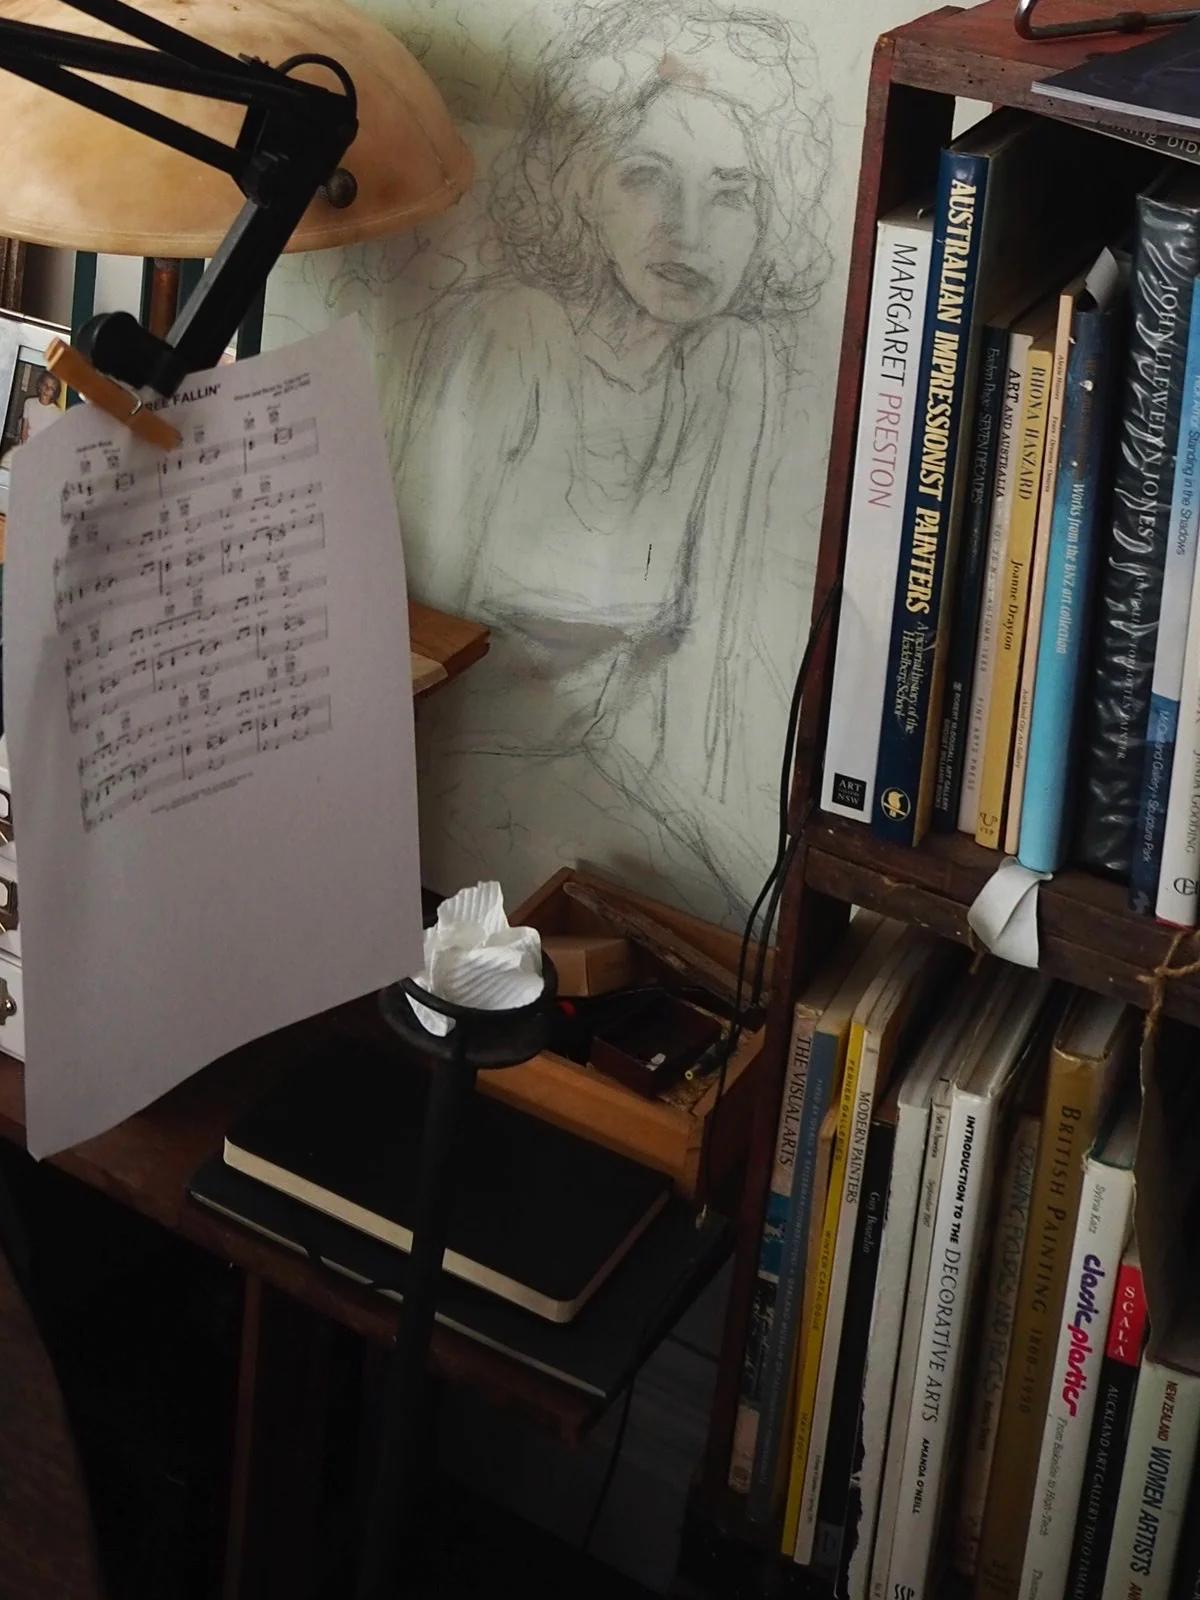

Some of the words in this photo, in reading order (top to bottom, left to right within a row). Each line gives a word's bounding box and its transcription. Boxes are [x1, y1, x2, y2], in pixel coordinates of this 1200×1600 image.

[936, 179, 977, 324] AUSTRALIAN
[881, 242, 918, 386] MARGARET
[1156, 282, 1180, 342] JOHN
[1005, 368, 1022, 403] ART
[1026, 367, 1046, 420] RHONA
[918, 330, 962, 500] IMPRESSIONIST
[1002, 405, 1014, 429] AND
[868, 392, 903, 508] PRESTON
[995, 432, 1010, 499] AUSTRALIA
[1018, 428, 1041, 500] HASZARD
[1182, 430, 1199, 475] Standing
[1069, 483, 1085, 516] Works
[1138, 468, 1161, 539] JONES
[1181, 489, 1194, 506] the
[1184, 477, 1195, 487] in
[1064, 545, 1080, 561] the
[1067, 517, 1082, 543] from
[1175, 508, 1193, 555] Shadows
[905, 507, 941, 614] PAINTERS
[1011, 560, 1024, 600] Joanne
[1063, 563, 1077, 586] BNZ
[1061, 588, 1075, 603] art
[1003, 604, 1020, 650] Drayton
[1055, 605, 1074, 654] collection
[908, 671, 924, 703] history
[793, 1036, 813, 1068] THE
[783, 1072, 809, 1122] VISUAL
[854, 1091, 872, 1145] MODERN
[779, 1127, 799, 1166] ARTS
[955, 1115, 976, 1202] INTRODUCTION
[1049, 1105, 1082, 1196] BRITISH
[845, 1147, 864, 1205] PAINTERS
[949, 1222, 961, 1244] THE
[952, 1204, 964, 1219] TO
[1031, 1206, 1067, 1313] PAINTING
[929, 1248, 961, 1373] DECORATIVE
[1113, 1285, 1136, 1357] SCALA
[921, 1376, 942, 1422] ARTS
[1163, 1381, 1178, 1403] NEW
[1099, 1386, 1119, 1447] AUCKLAND
[1156, 1403, 1176, 1442] ZEALAND
[917, 1438, 930, 1477] AMANDA
[1095, 1449, 1108, 1471] ART
[1141, 1446, 1172, 1510] WOMEN
[912, 1479, 925, 1515] O'NEILL
[1086, 1474, 1104, 1522] GALLERY
[1129, 1509, 1159, 1576] ARTISTS
